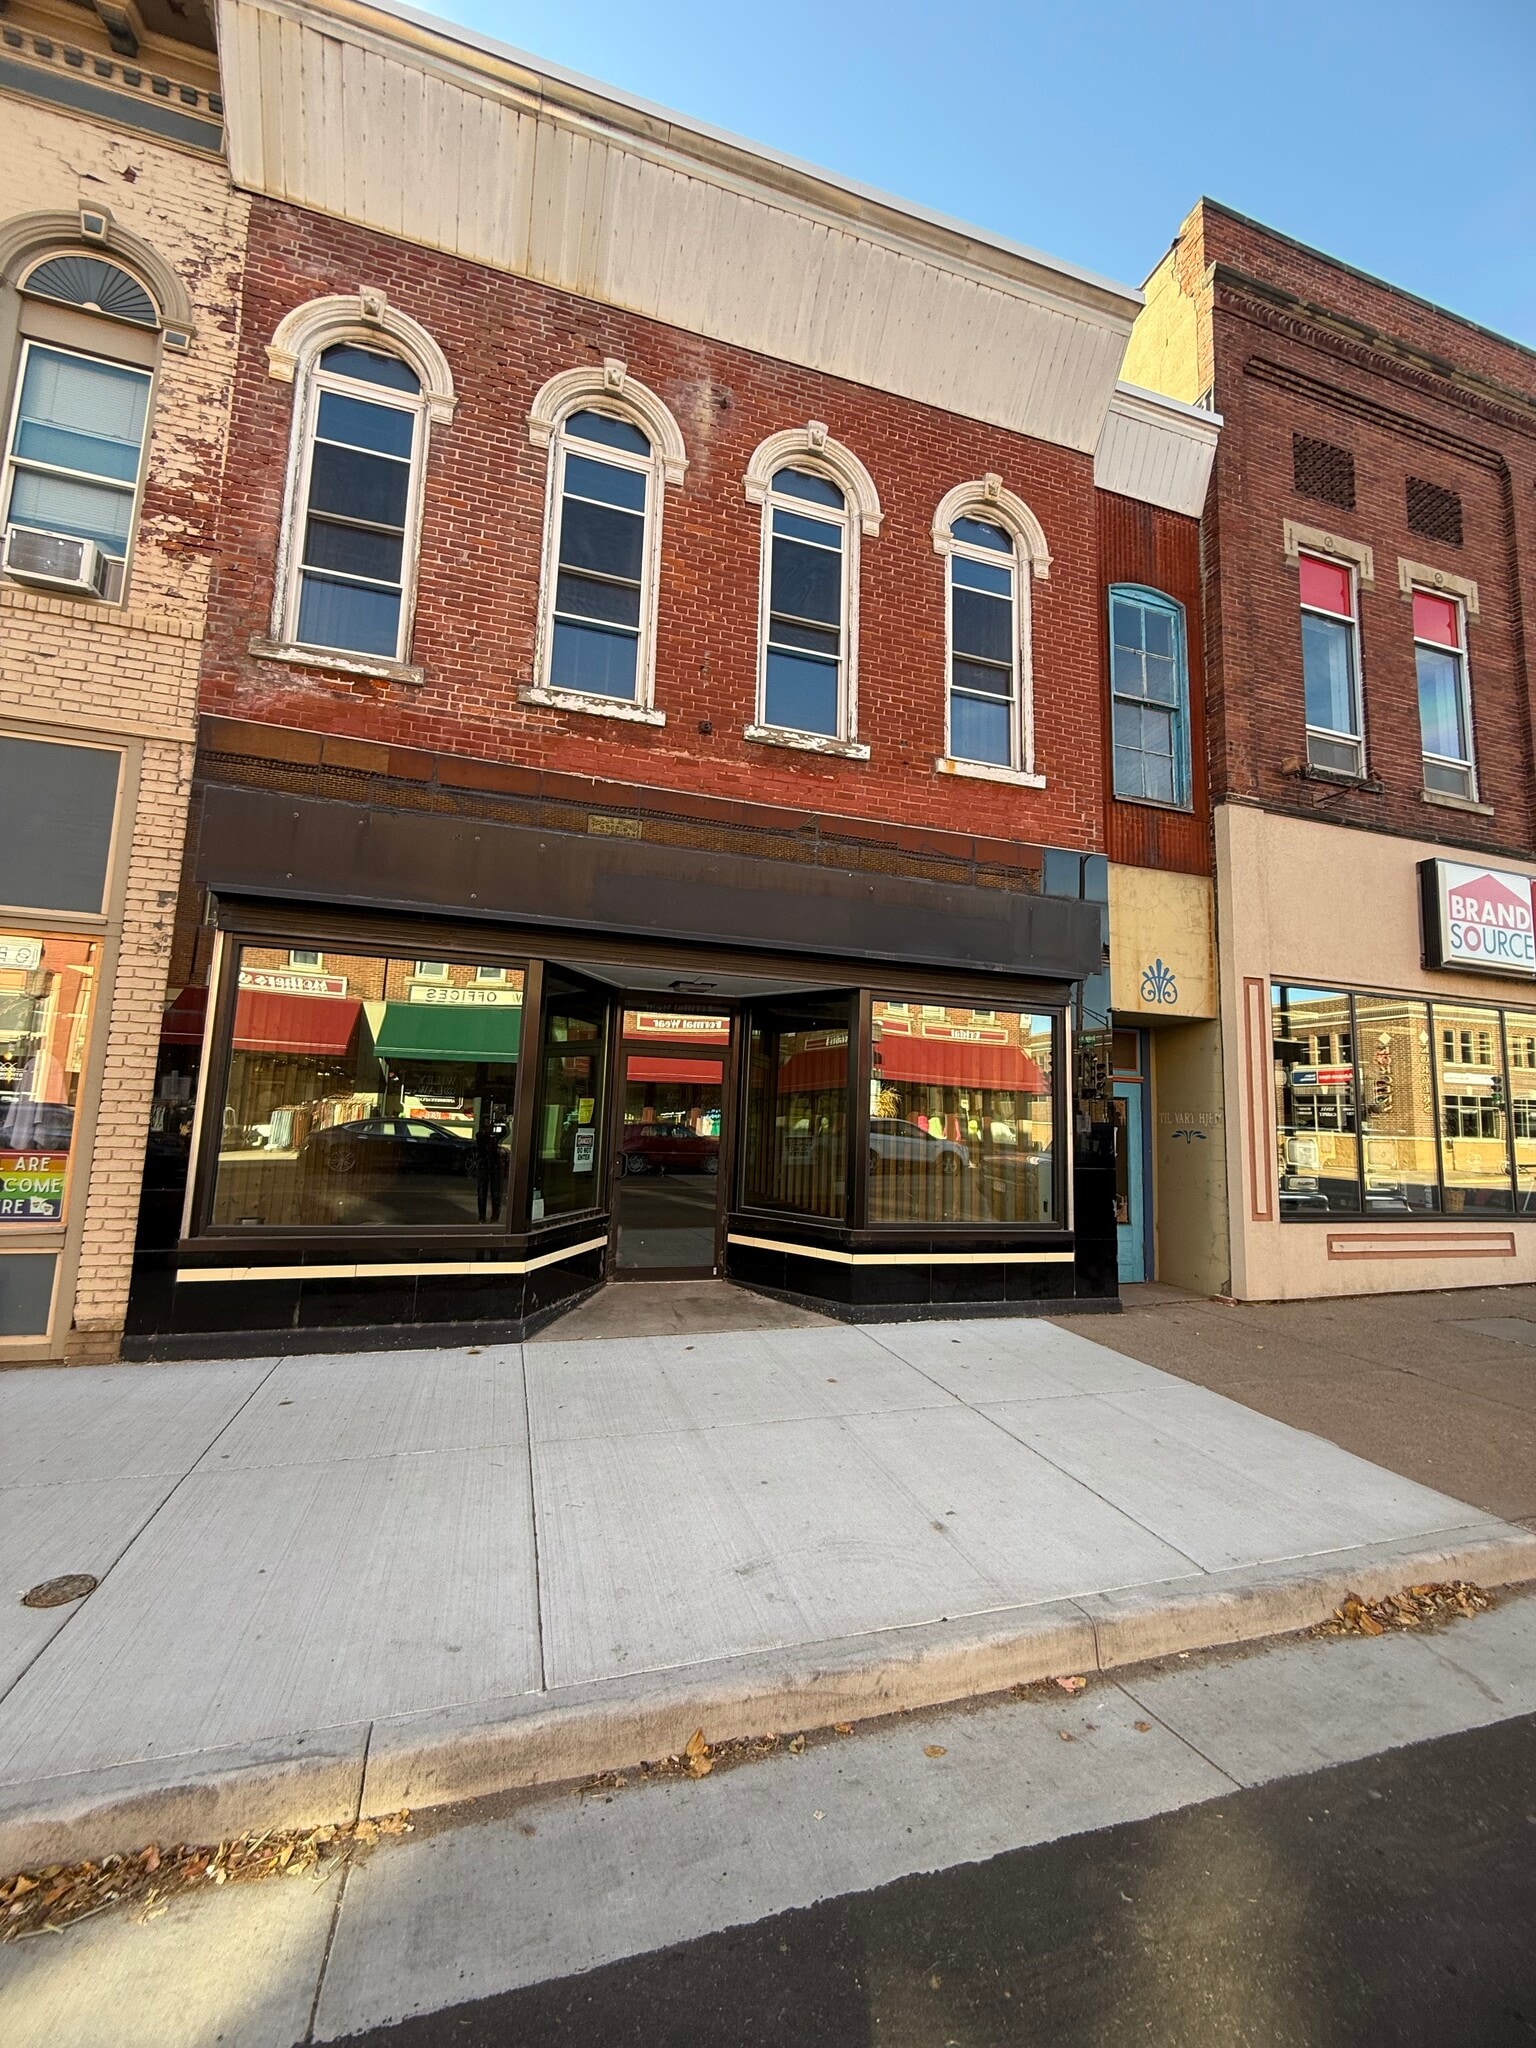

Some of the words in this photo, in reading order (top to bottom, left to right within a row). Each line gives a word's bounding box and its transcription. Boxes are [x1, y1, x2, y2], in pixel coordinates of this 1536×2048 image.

[1451, 894, 1531, 930] BRAND
[1450, 923, 1535, 960] SOURCE
[14, 1156, 51, 1172] ARE
[3, 1178, 63, 1193] COME
[0, 1199, 25, 1214] RE
